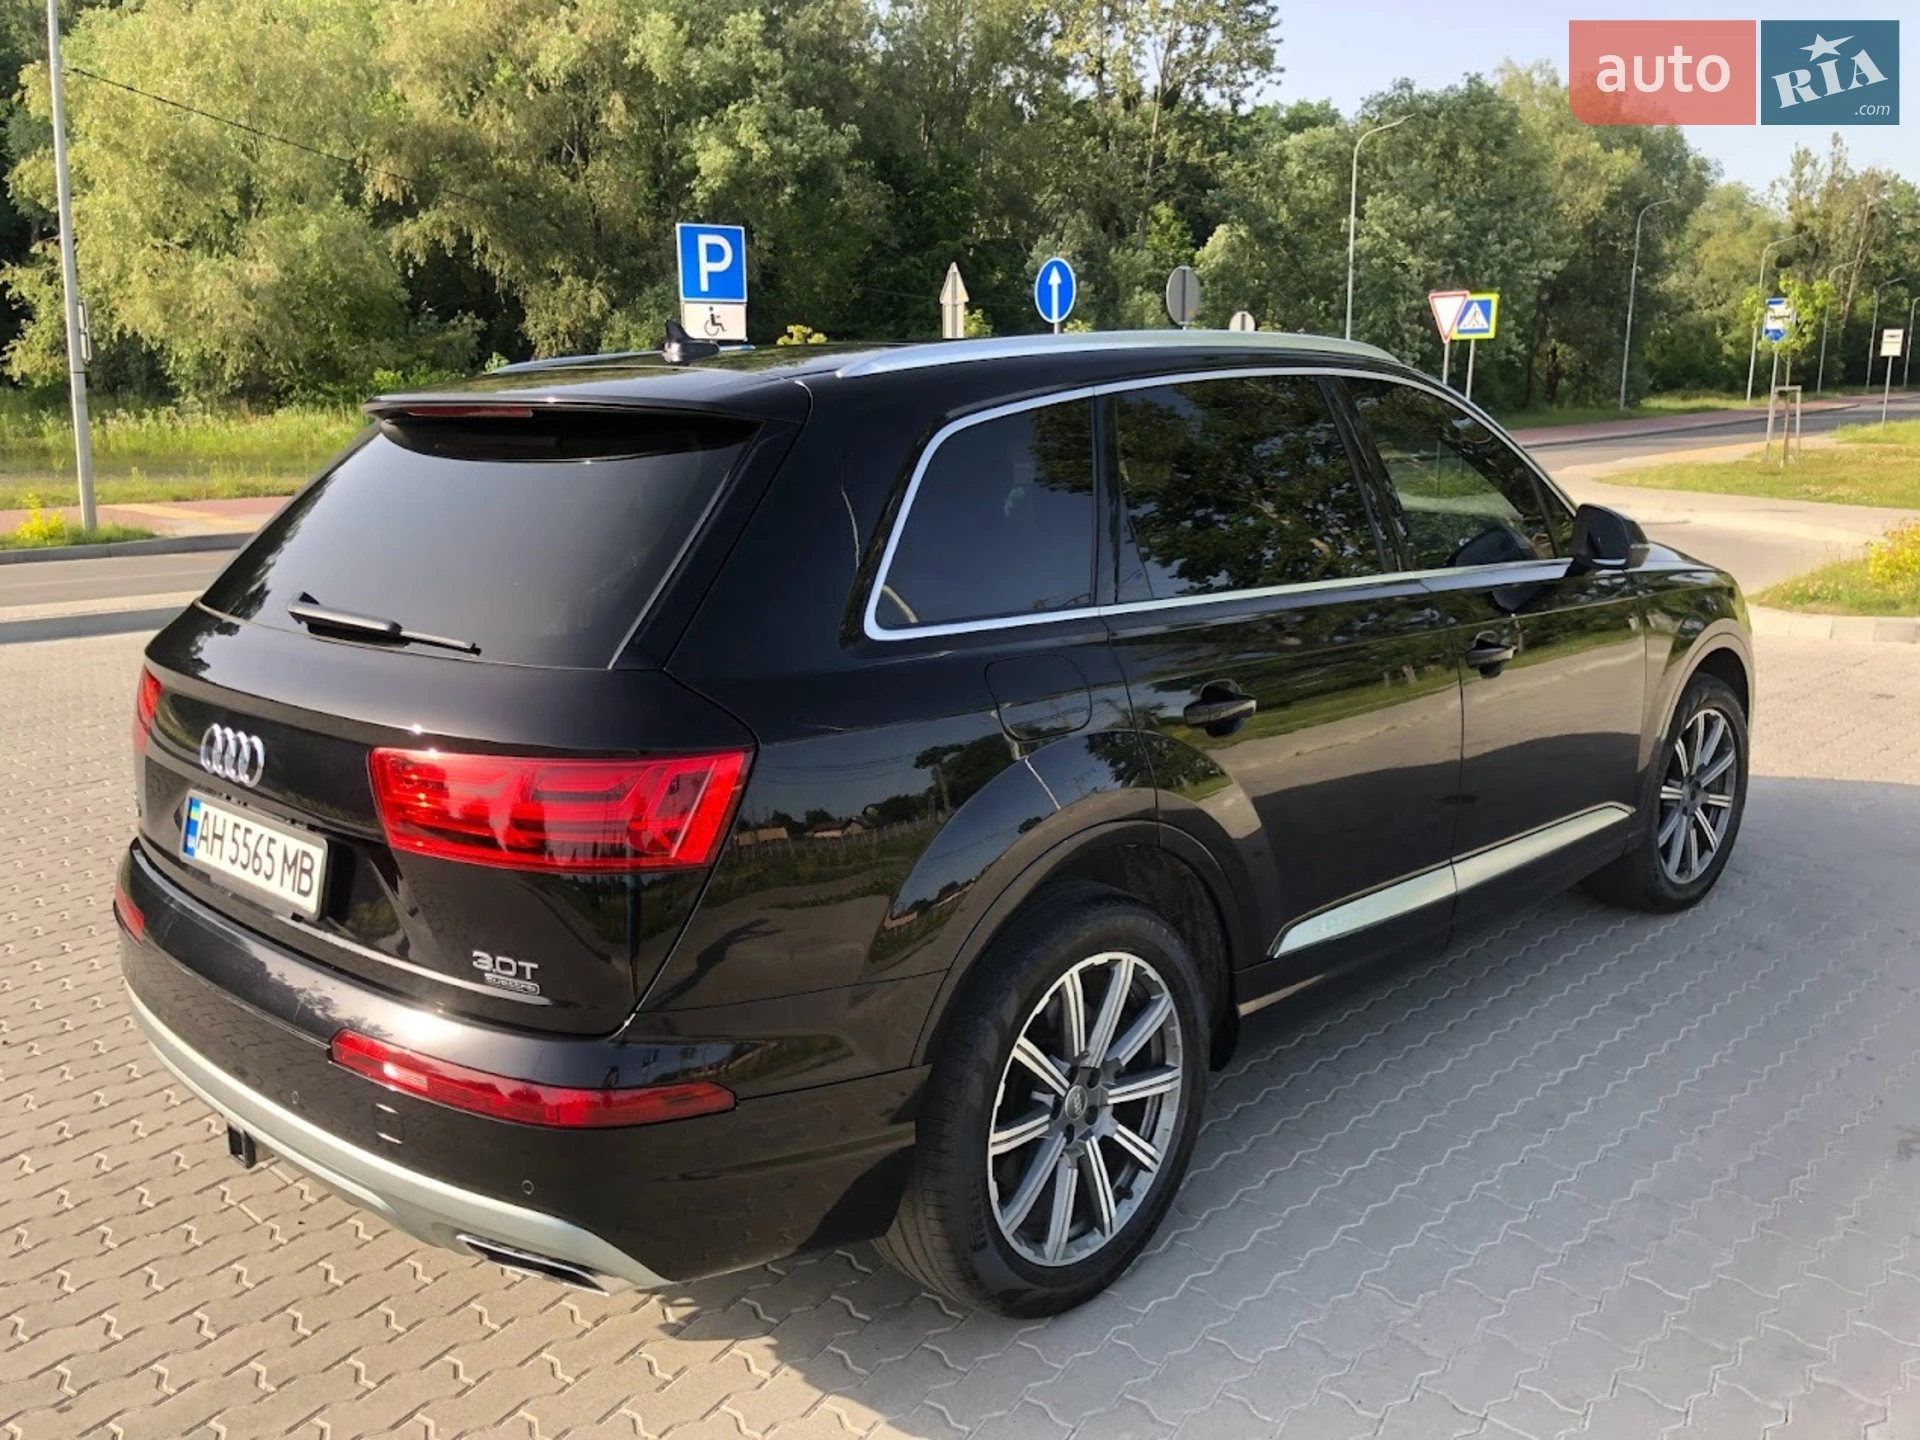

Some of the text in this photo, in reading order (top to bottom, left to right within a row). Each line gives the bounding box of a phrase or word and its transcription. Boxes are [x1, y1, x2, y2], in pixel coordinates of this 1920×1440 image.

[698, 234, 734, 292] P
[197, 810, 315, 898] AH 5565 MB
